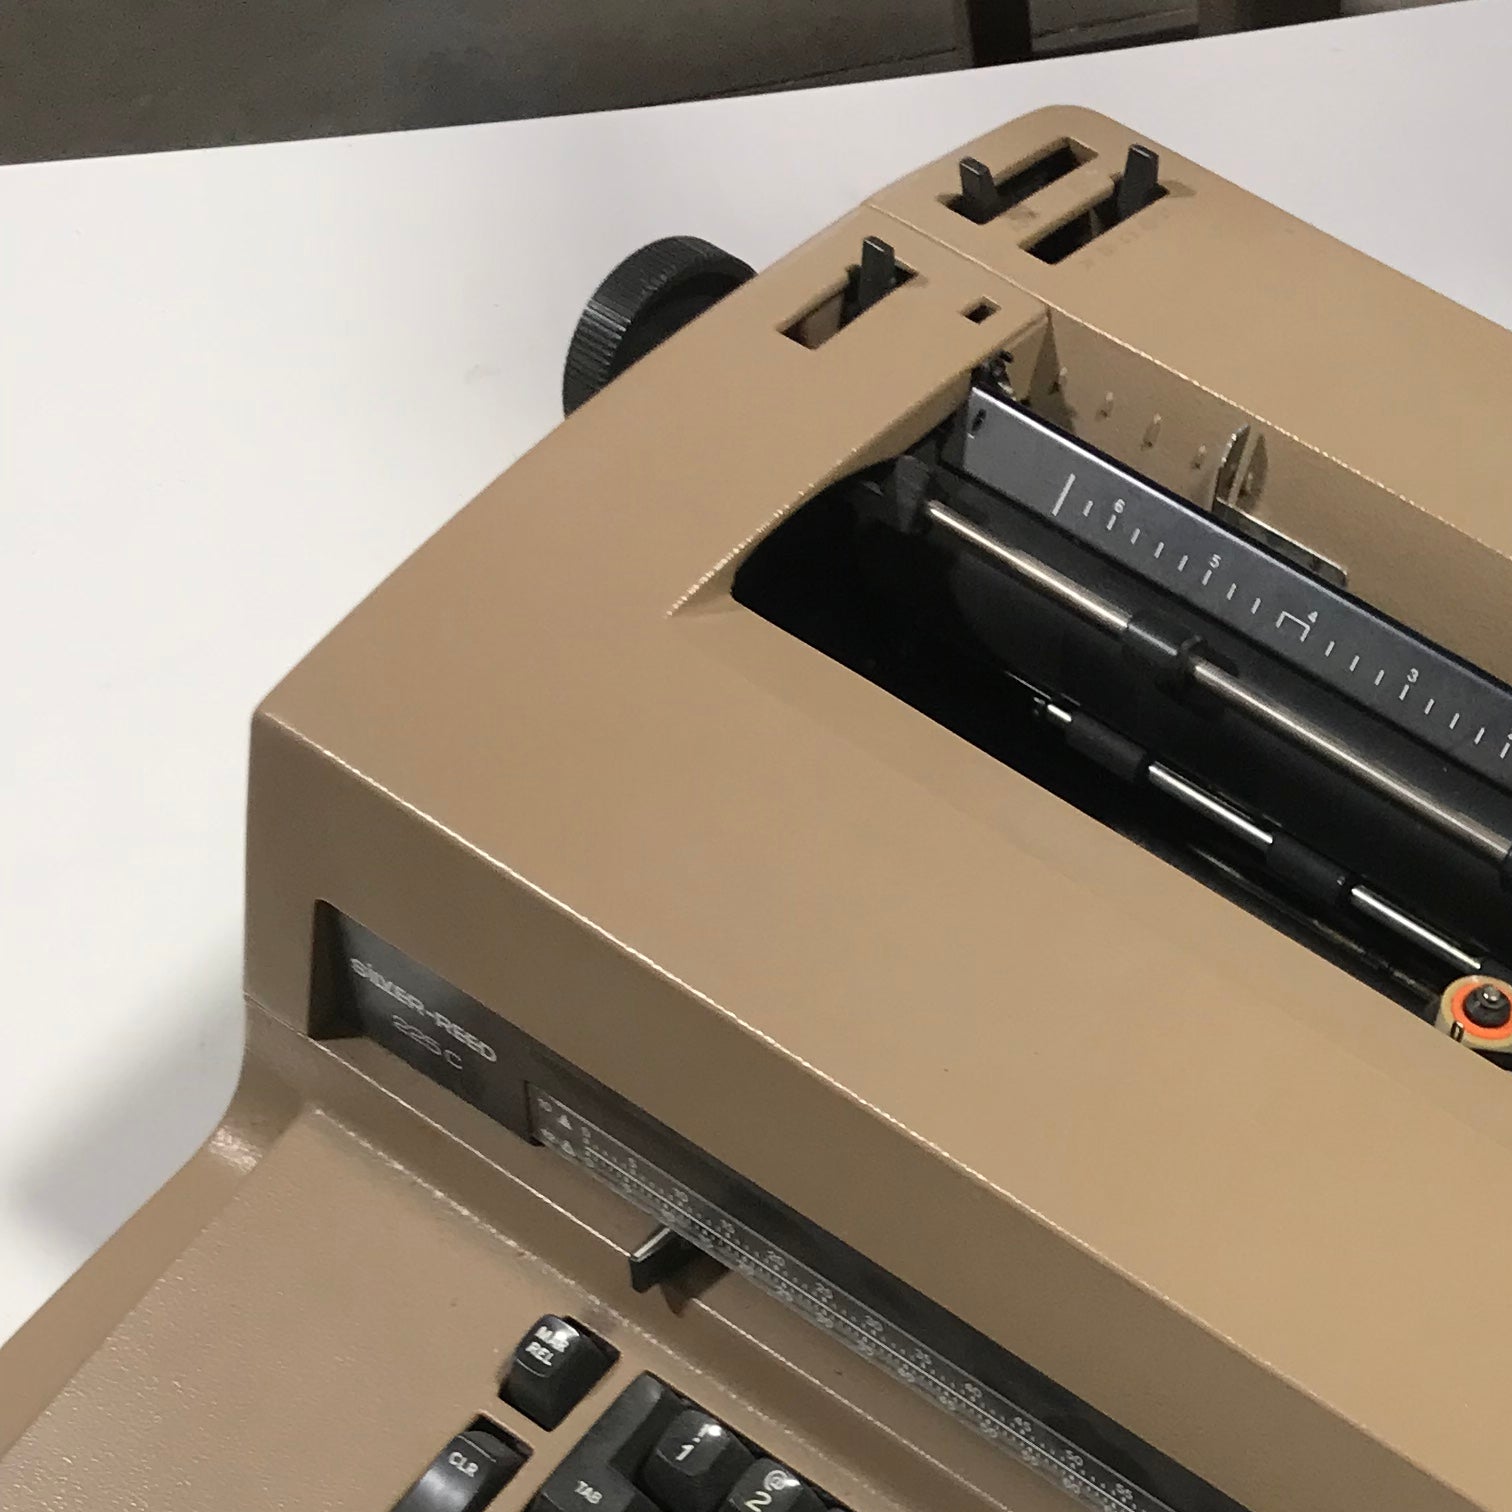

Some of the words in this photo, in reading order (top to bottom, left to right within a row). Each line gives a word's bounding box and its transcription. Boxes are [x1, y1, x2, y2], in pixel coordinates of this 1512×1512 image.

[1114, 499, 1125, 513] 6
[1210, 554, 1221, 568] 5
[1307, 611, 1318, 623] 4
[1407, 668, 1418, 682] 3
[444, 1049, 463, 1069] C
[676, 1445, 694, 1460] 1
[449, 1452, 478, 1477] CLR
[763, 1470, 789, 1491] @
[575, 1481, 602, 1504] TAB
[745, 1491, 771, 1512] 2
